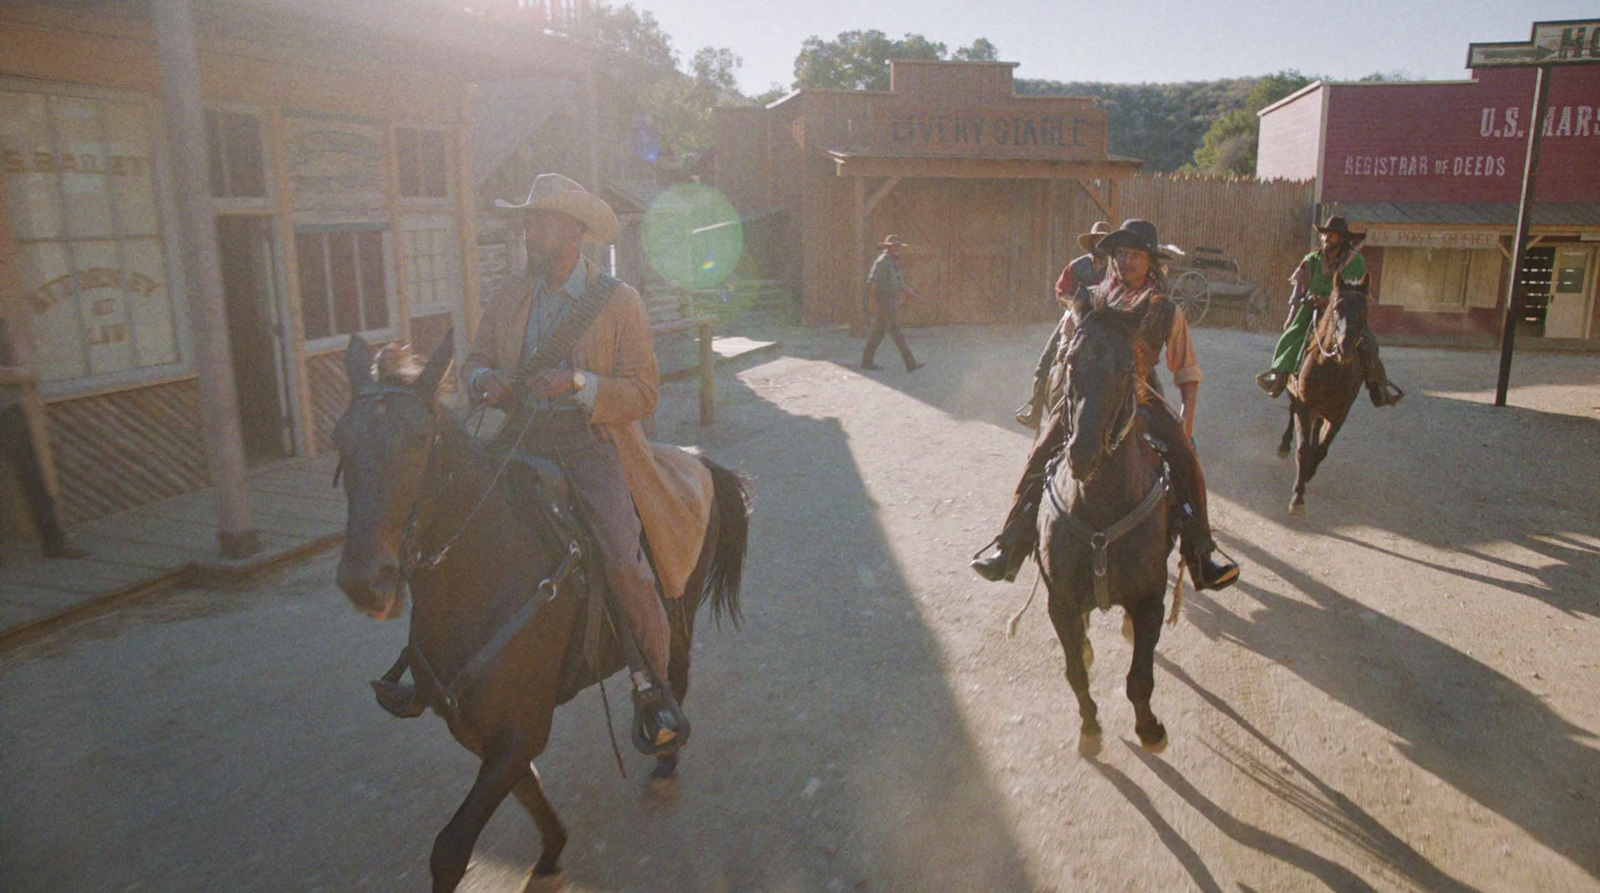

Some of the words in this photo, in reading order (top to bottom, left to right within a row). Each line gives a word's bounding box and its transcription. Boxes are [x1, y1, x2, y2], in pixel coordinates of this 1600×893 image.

[893, 112, 985, 145] LIVERY
[993, 117, 1087, 147] STABLE
[1480, 107, 1524, 138] U.S.
[1344, 155, 1428, 177] REGISTRAR
[1435, 159, 1449, 175] OF
[1453, 155, 1506, 177] DEEDS
